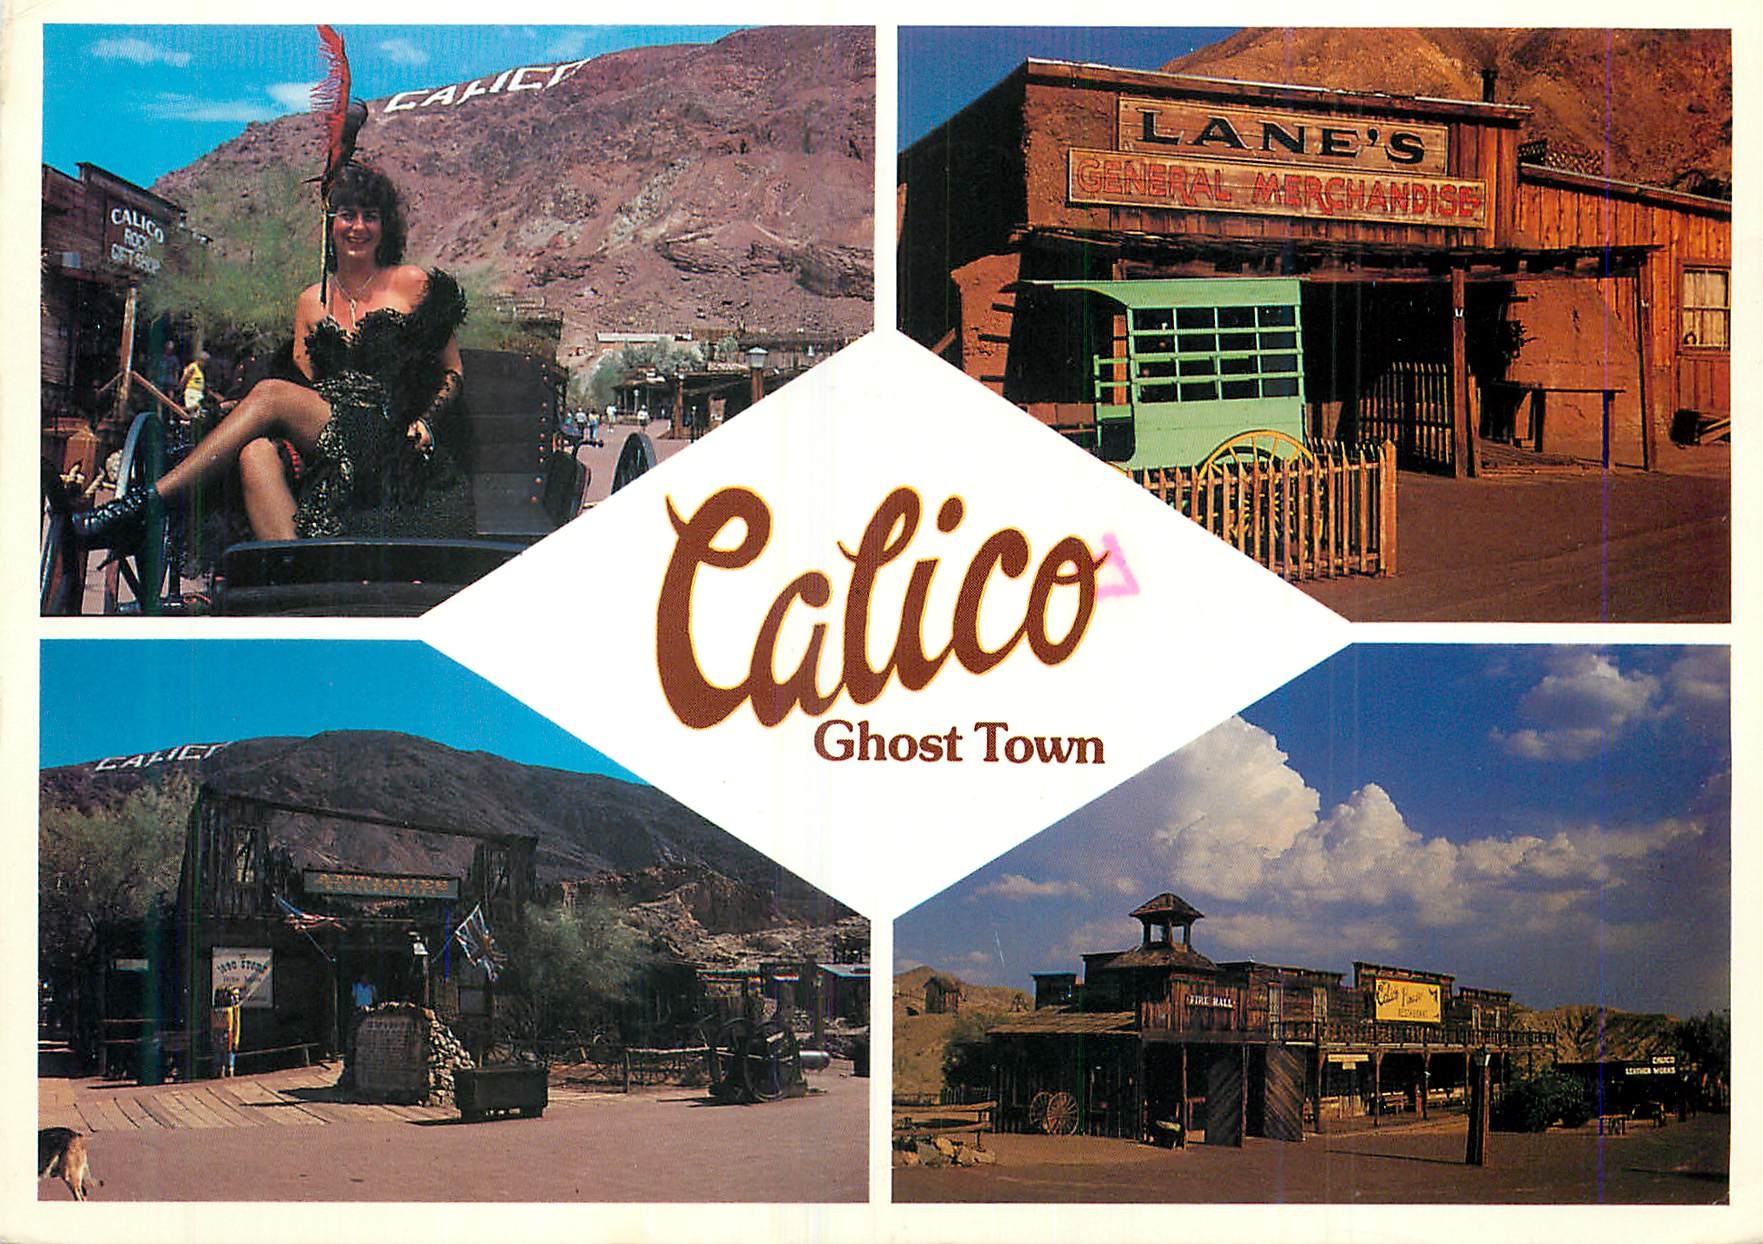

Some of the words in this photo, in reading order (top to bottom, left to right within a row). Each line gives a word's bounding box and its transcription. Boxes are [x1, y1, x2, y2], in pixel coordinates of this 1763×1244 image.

[384, 57, 591, 113] CALICO
[1135, 106, 1427, 165] LANE'S
[1076, 157, 1233, 207] GENERAL
[1253, 172, 1481, 217] MERCHANDISE
[111, 208, 164, 244] CALICO
